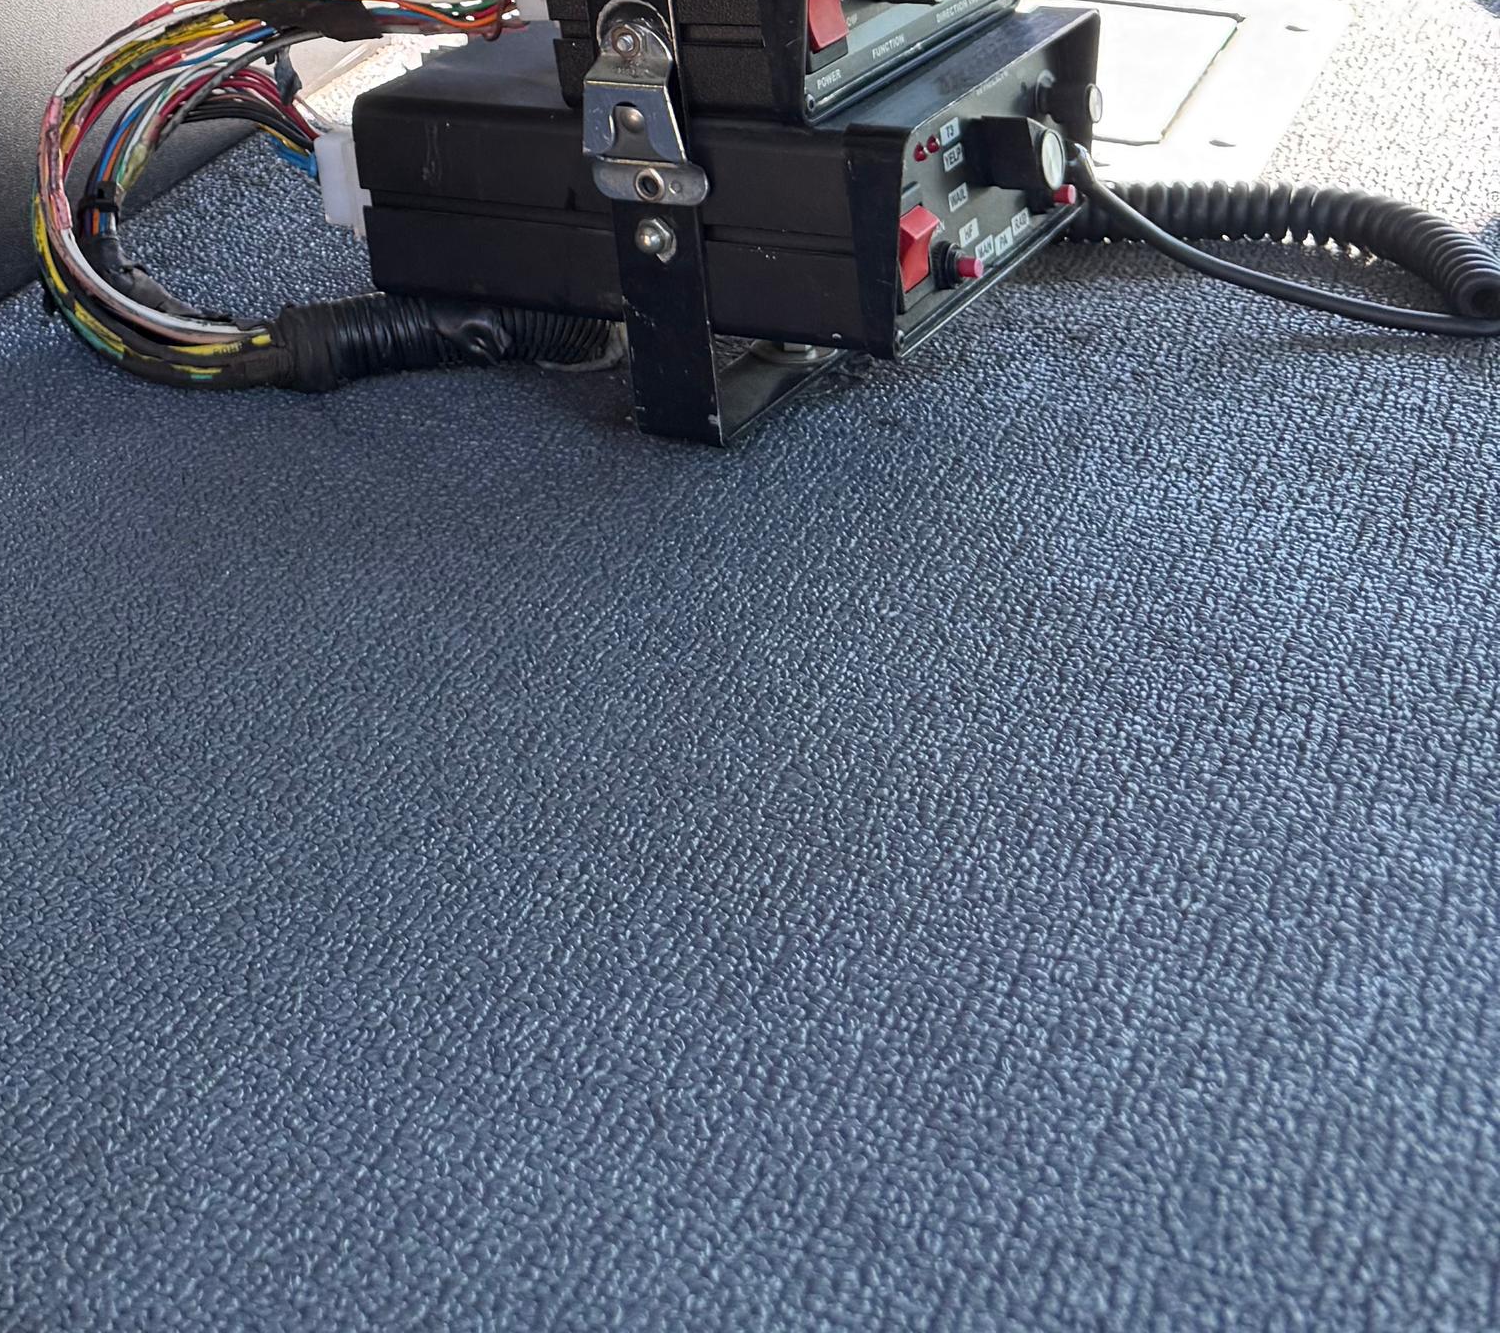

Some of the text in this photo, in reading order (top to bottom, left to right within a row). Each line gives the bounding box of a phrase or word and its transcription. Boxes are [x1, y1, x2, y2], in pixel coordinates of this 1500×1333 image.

[871, 35, 905, 59] FUNCTION
[816, 69, 842, 90] POWER
[945, 147, 962, 167] YELP
